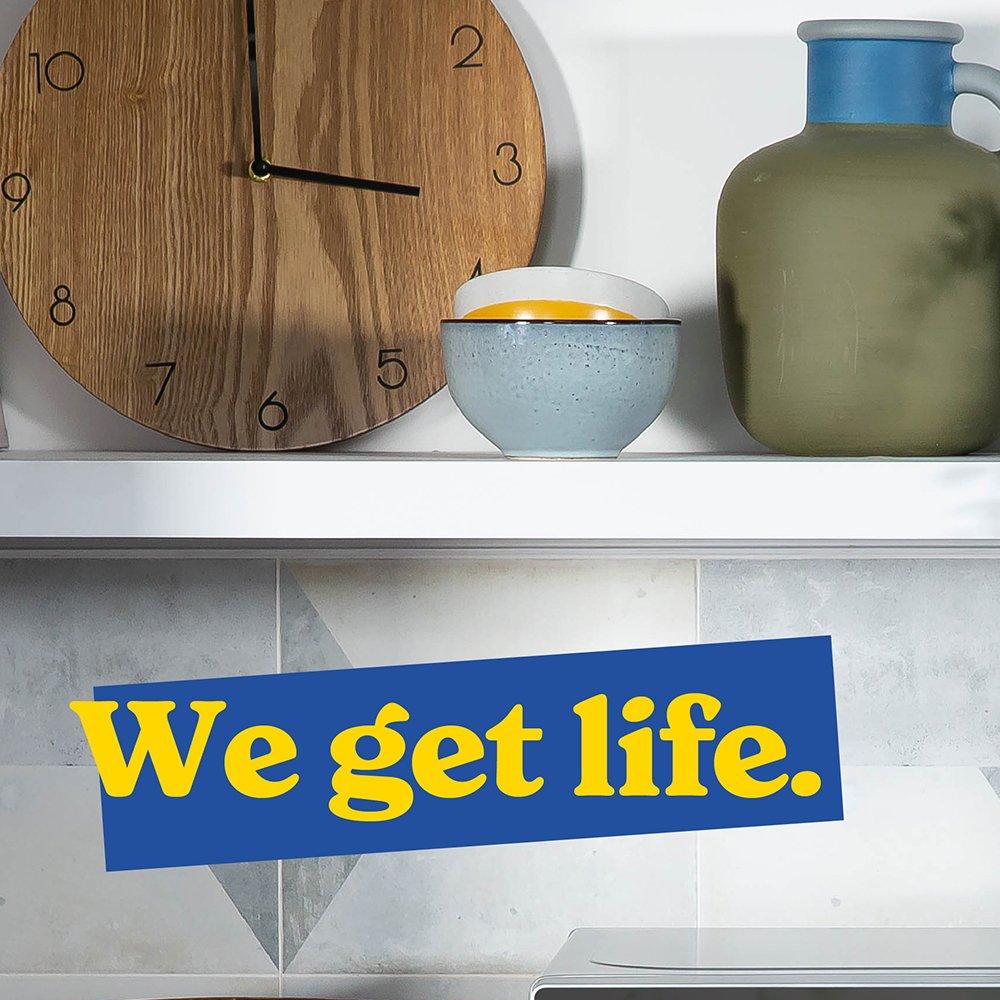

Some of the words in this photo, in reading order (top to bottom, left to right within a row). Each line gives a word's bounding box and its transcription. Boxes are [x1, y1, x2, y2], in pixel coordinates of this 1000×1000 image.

[450, 24, 484, 69] 2
[29, 50, 86, 94] 10
[492, 141, 522, 186] 3
[1, 172, 31, 212] 9
[49, 284, 76, 327] 8
[145, 361, 177, 405] 7
[376, 348, 408, 390] 5
[257, 391, 289, 431] 6
